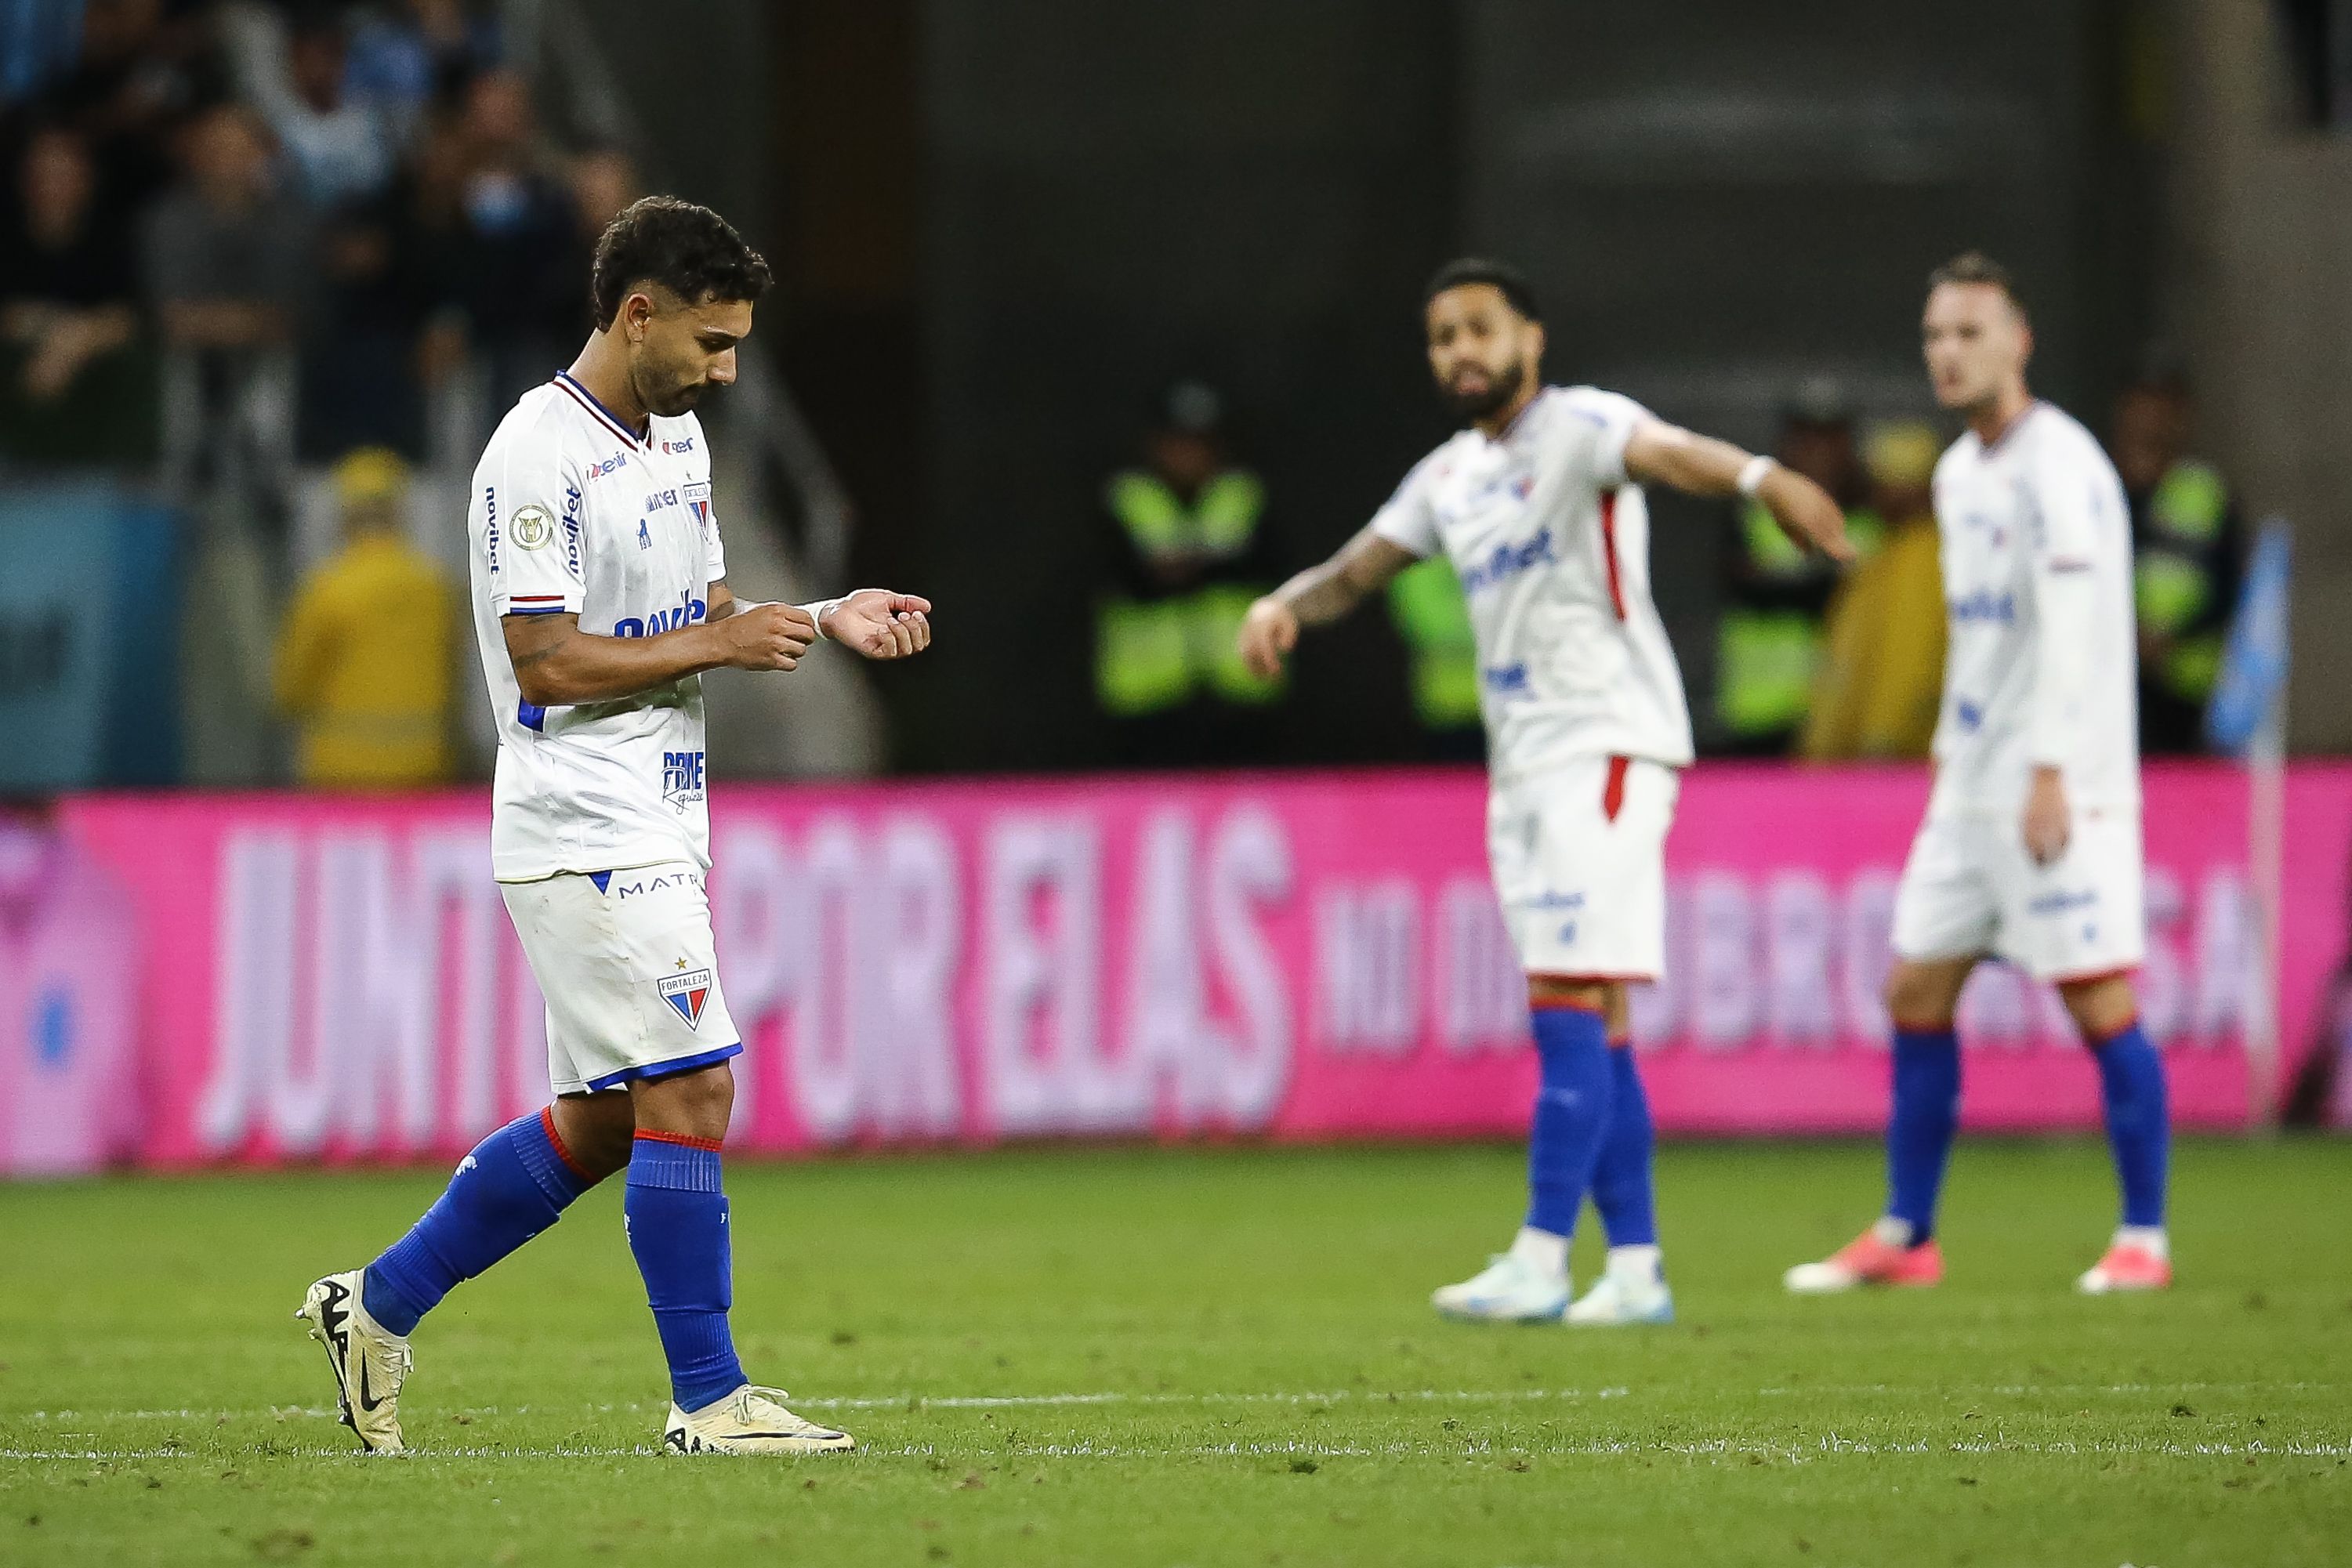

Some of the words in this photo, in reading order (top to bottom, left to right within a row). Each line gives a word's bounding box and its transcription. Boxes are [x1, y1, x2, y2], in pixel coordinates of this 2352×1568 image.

[485, 487, 500, 575] novibet
[200, 829, 545, 1148] JUNT
[719, 811, 952, 1143] POR
[988, 807, 1295, 1135] ELAS
[661, 973, 708, 991] FORTALEZA
